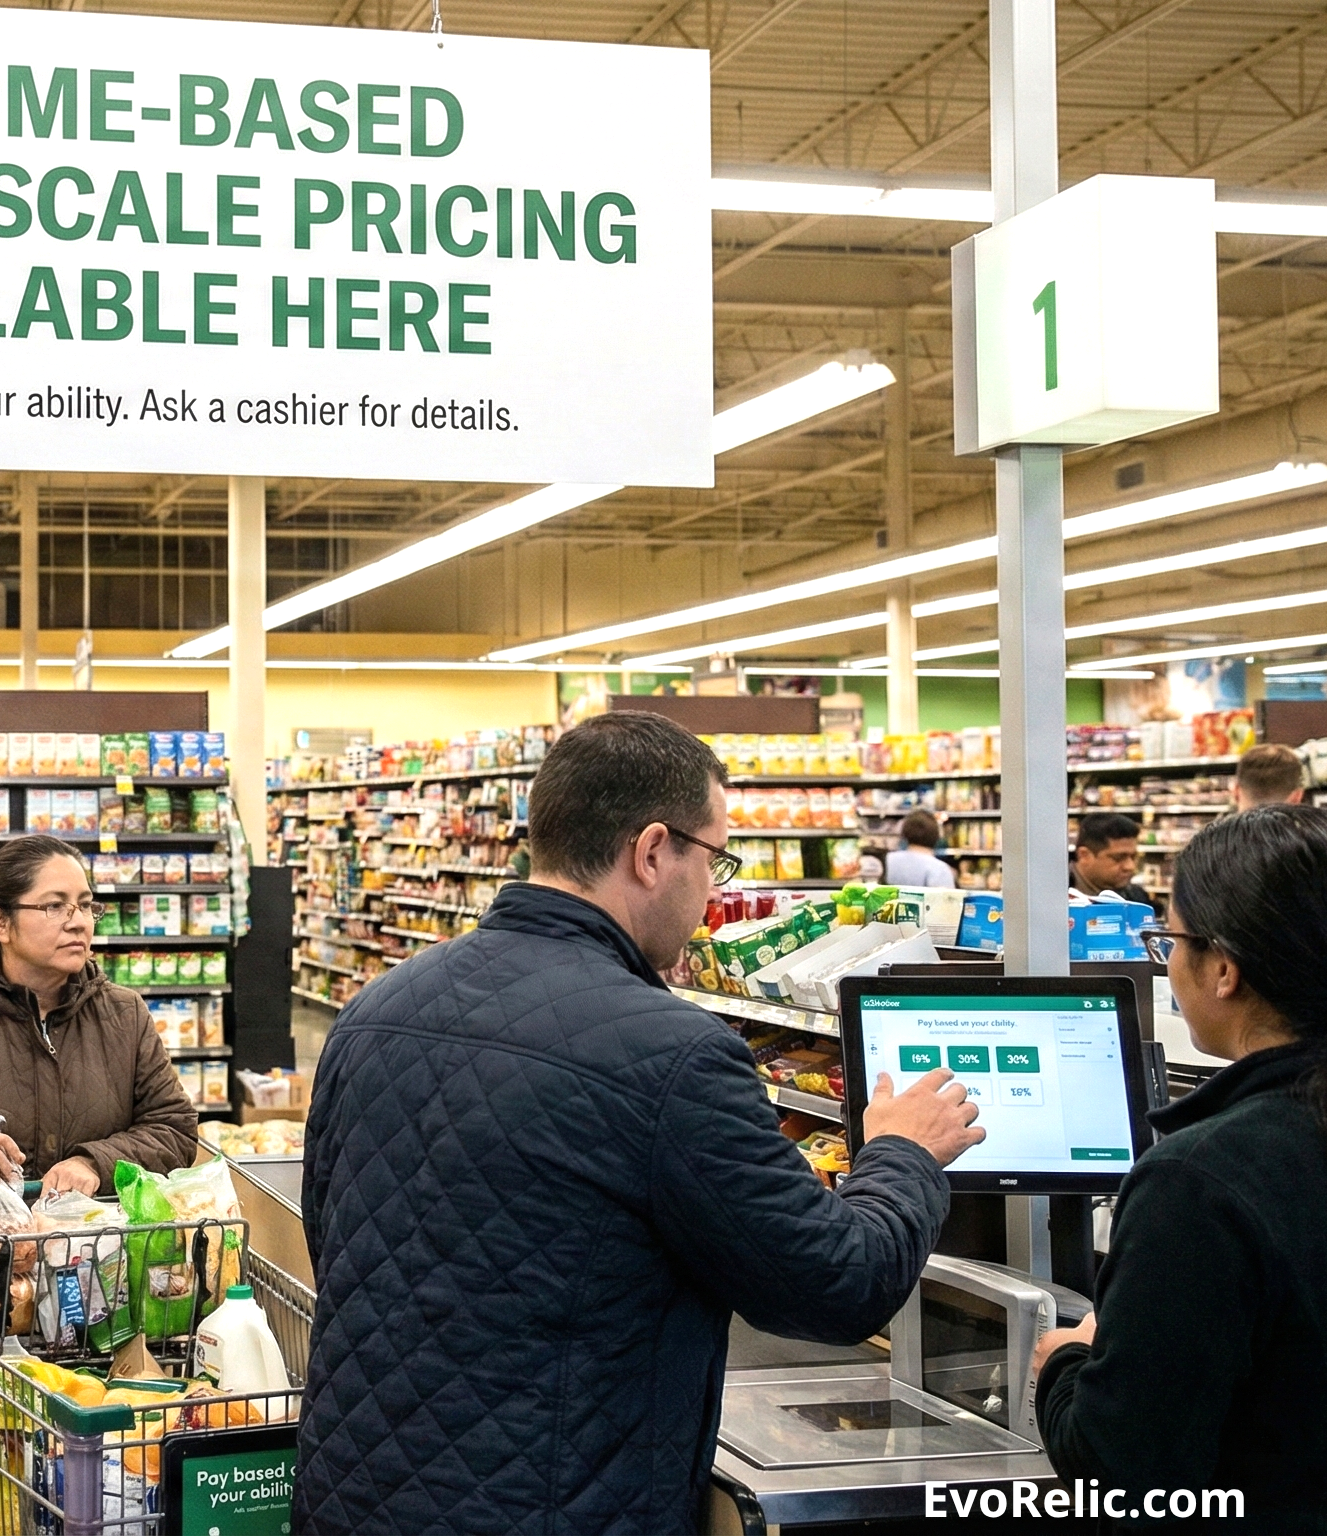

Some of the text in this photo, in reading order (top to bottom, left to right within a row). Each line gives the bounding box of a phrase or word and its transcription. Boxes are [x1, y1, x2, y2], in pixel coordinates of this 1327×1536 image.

[294, 177, 637, 265] PRICING
[271, 275, 492, 355] HERE
[1032, 280, 1058, 392] 1
[27, 385, 129, 428] ability.
[139, 388, 198, 422] Ask
[208, 398, 226, 423] a
[236, 392, 350, 426] cashier
[358, 394, 402, 428] for
[411, 396, 520, 433] details.
[197, 1470, 229, 1490] Pay
[233, 1461, 285, 1483] based
[210, 1490, 247, 1509] your
